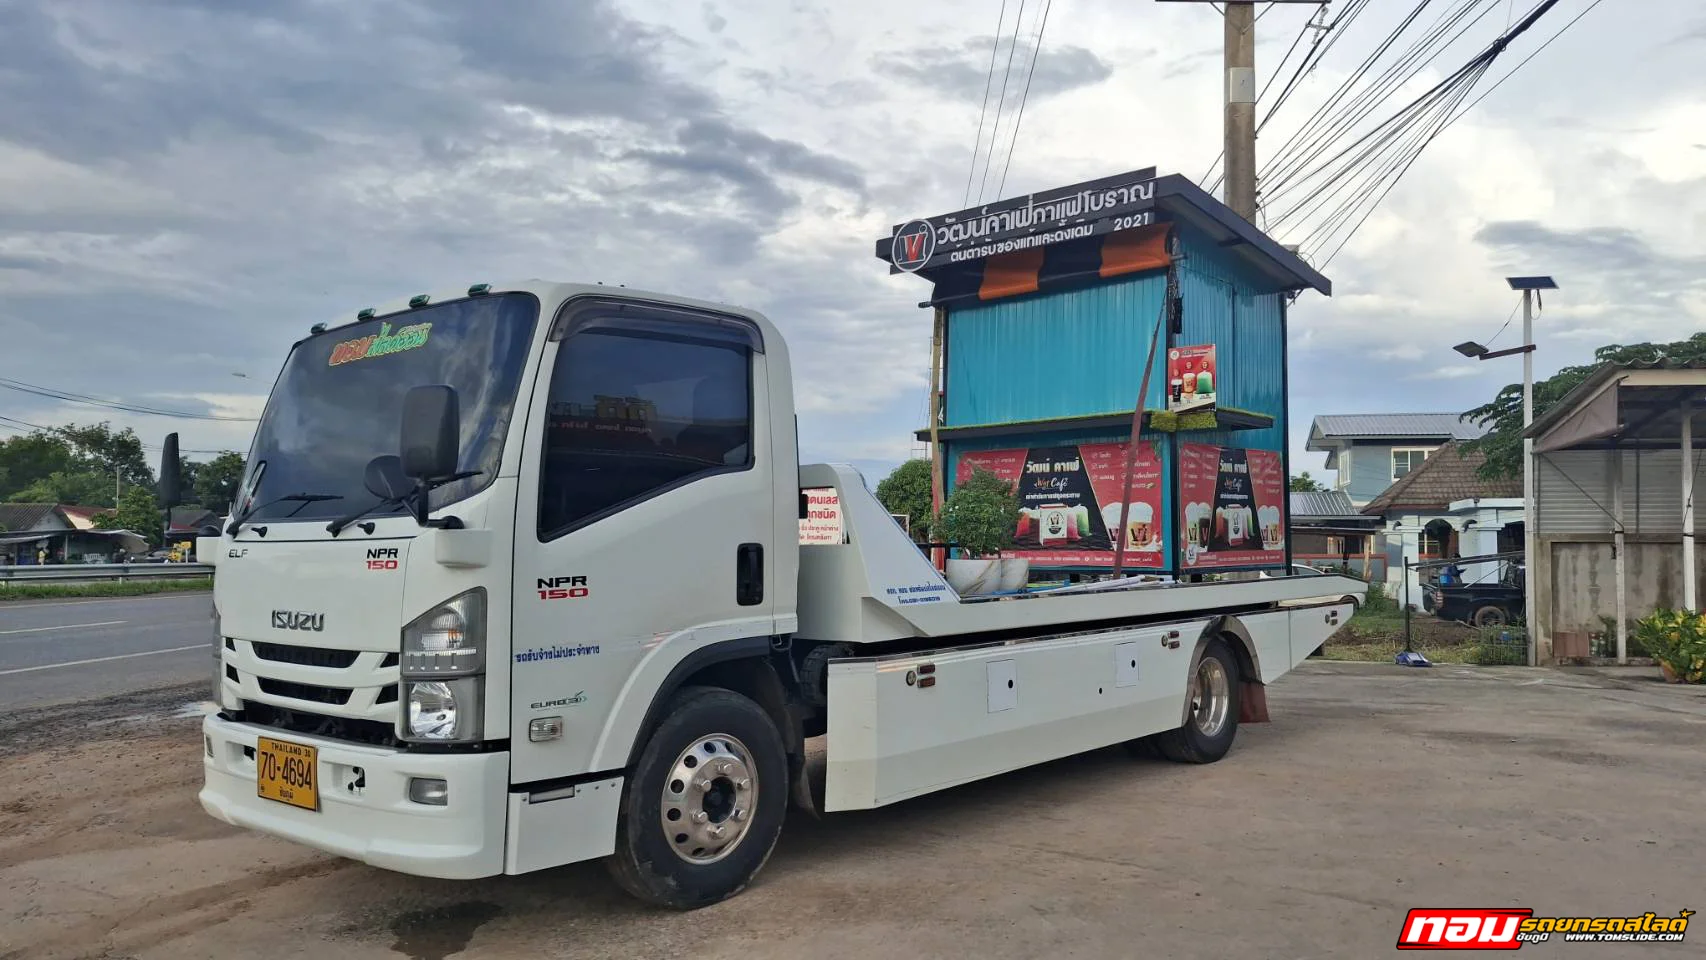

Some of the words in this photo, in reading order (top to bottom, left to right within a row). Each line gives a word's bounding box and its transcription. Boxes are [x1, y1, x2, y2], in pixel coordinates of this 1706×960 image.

[1113, 212, 1149, 231] 2021
[228, 549, 248, 558] ELF
[366, 548, 398, 559] NPR
[366, 560, 398, 570] 150
[537, 575, 587, 588] NPR
[537, 588, 589, 600] 150
[271, 609, 324, 632] ISUZU
[515, 643, 600, 662] รถรับจ้างไม่ประจำทาง
[271, 742, 302, 756] THAILAND
[261, 751, 312, 791] 70-4694
